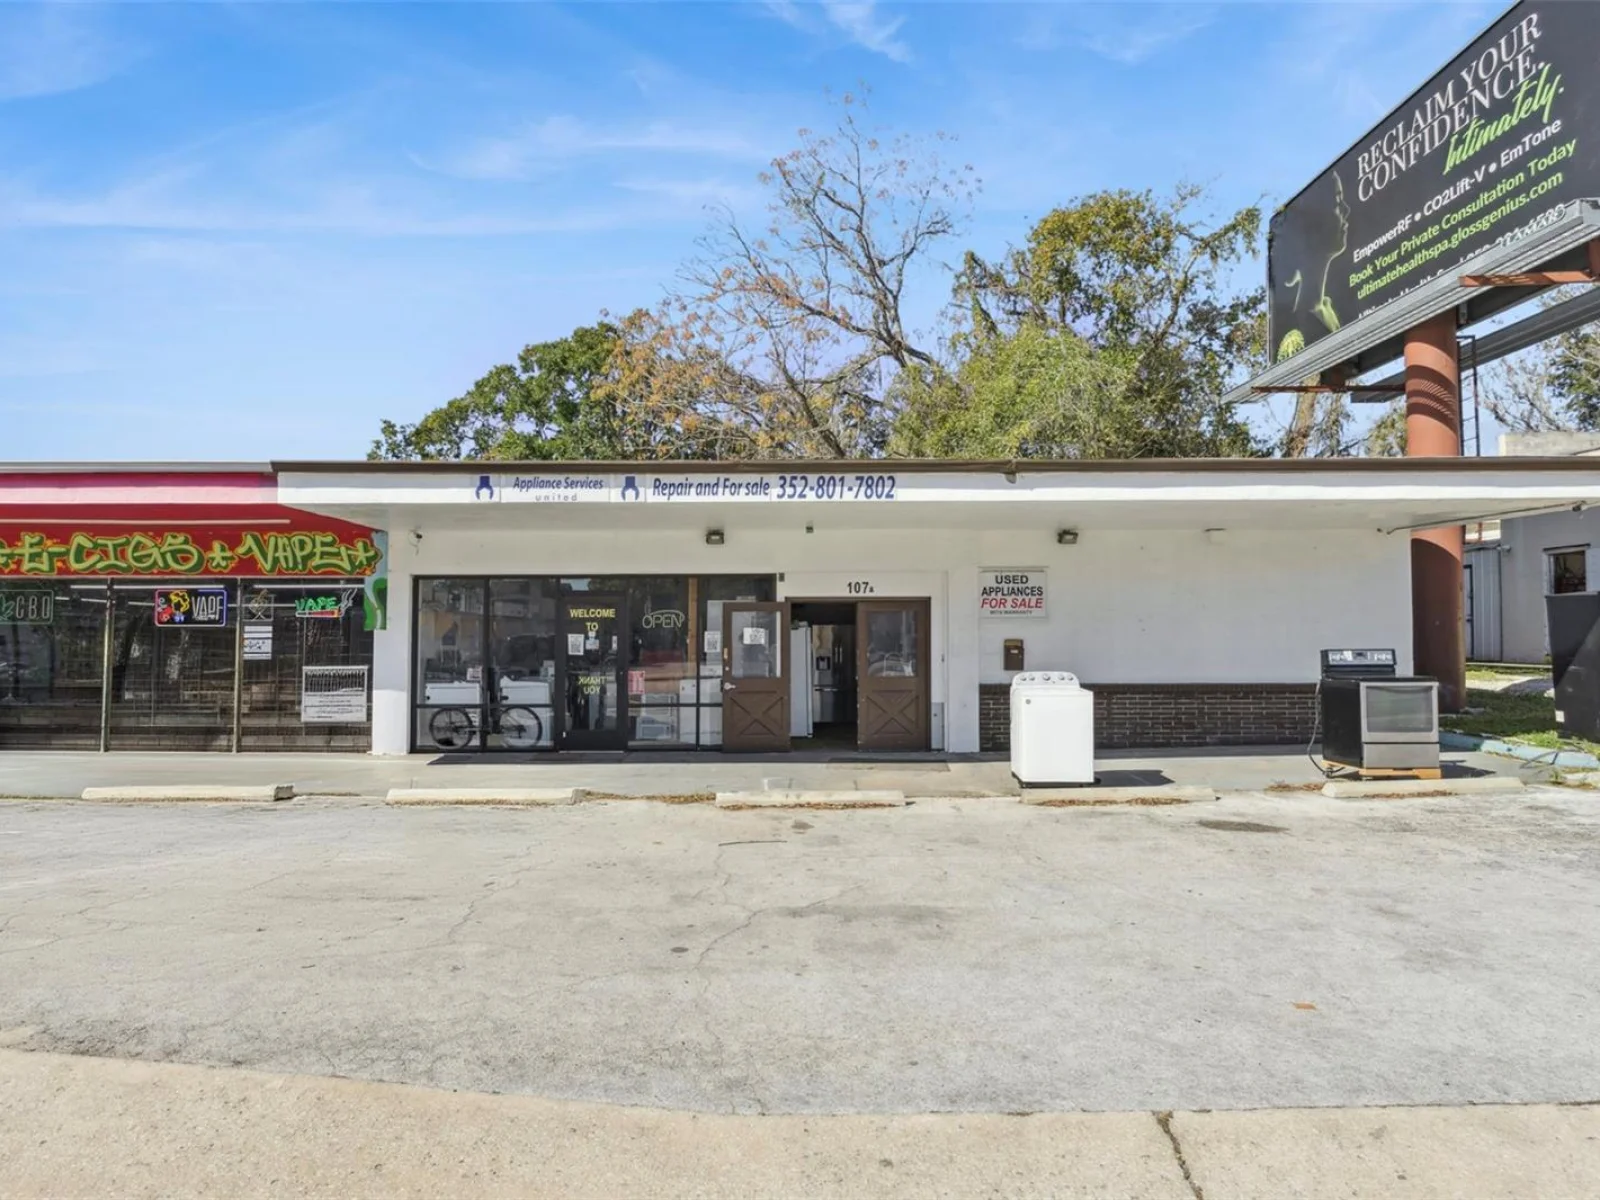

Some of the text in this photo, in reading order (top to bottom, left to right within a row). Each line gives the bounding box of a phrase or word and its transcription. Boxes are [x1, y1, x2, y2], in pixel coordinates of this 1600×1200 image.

[1357, 13, 1543, 180] RECLAIM YOUR
[1357, 44, 1546, 202] CONFIDENCE.
[1442, 62, 1564, 176] Intimately.
[1353, 213, 1413, 263] EmpowerRF
[1423, 165, 1486, 217] CO2Lift-V
[1500, 119, 1562, 168] EmTone
[1349, 266, 1374, 288] Book
[1374, 247, 1399, 271] Your
[1401, 222, 1440, 256] Private
[1441, 171, 1525, 230] Consultation
[1527, 139, 1577, 178] Today
[1356, 171, 1564, 300] ultimatehealthspa.glossgenius.com
[513, 476, 604, 493] Appliance Services
[652, 475, 896, 500] Repair and For sale 352-801-7802
[535, 493, 578, 501] united
[994, 575, 1029, 585] USED
[981, 586, 1044, 597] APPLIANCES
[295, 597, 337, 611] VAPE
[981, 598, 1044, 609] FOR SALE
[569, 608, 616, 618] WELCOME
[642, 613, 684, 629] OPEN
[585, 622, 599, 632] TO
